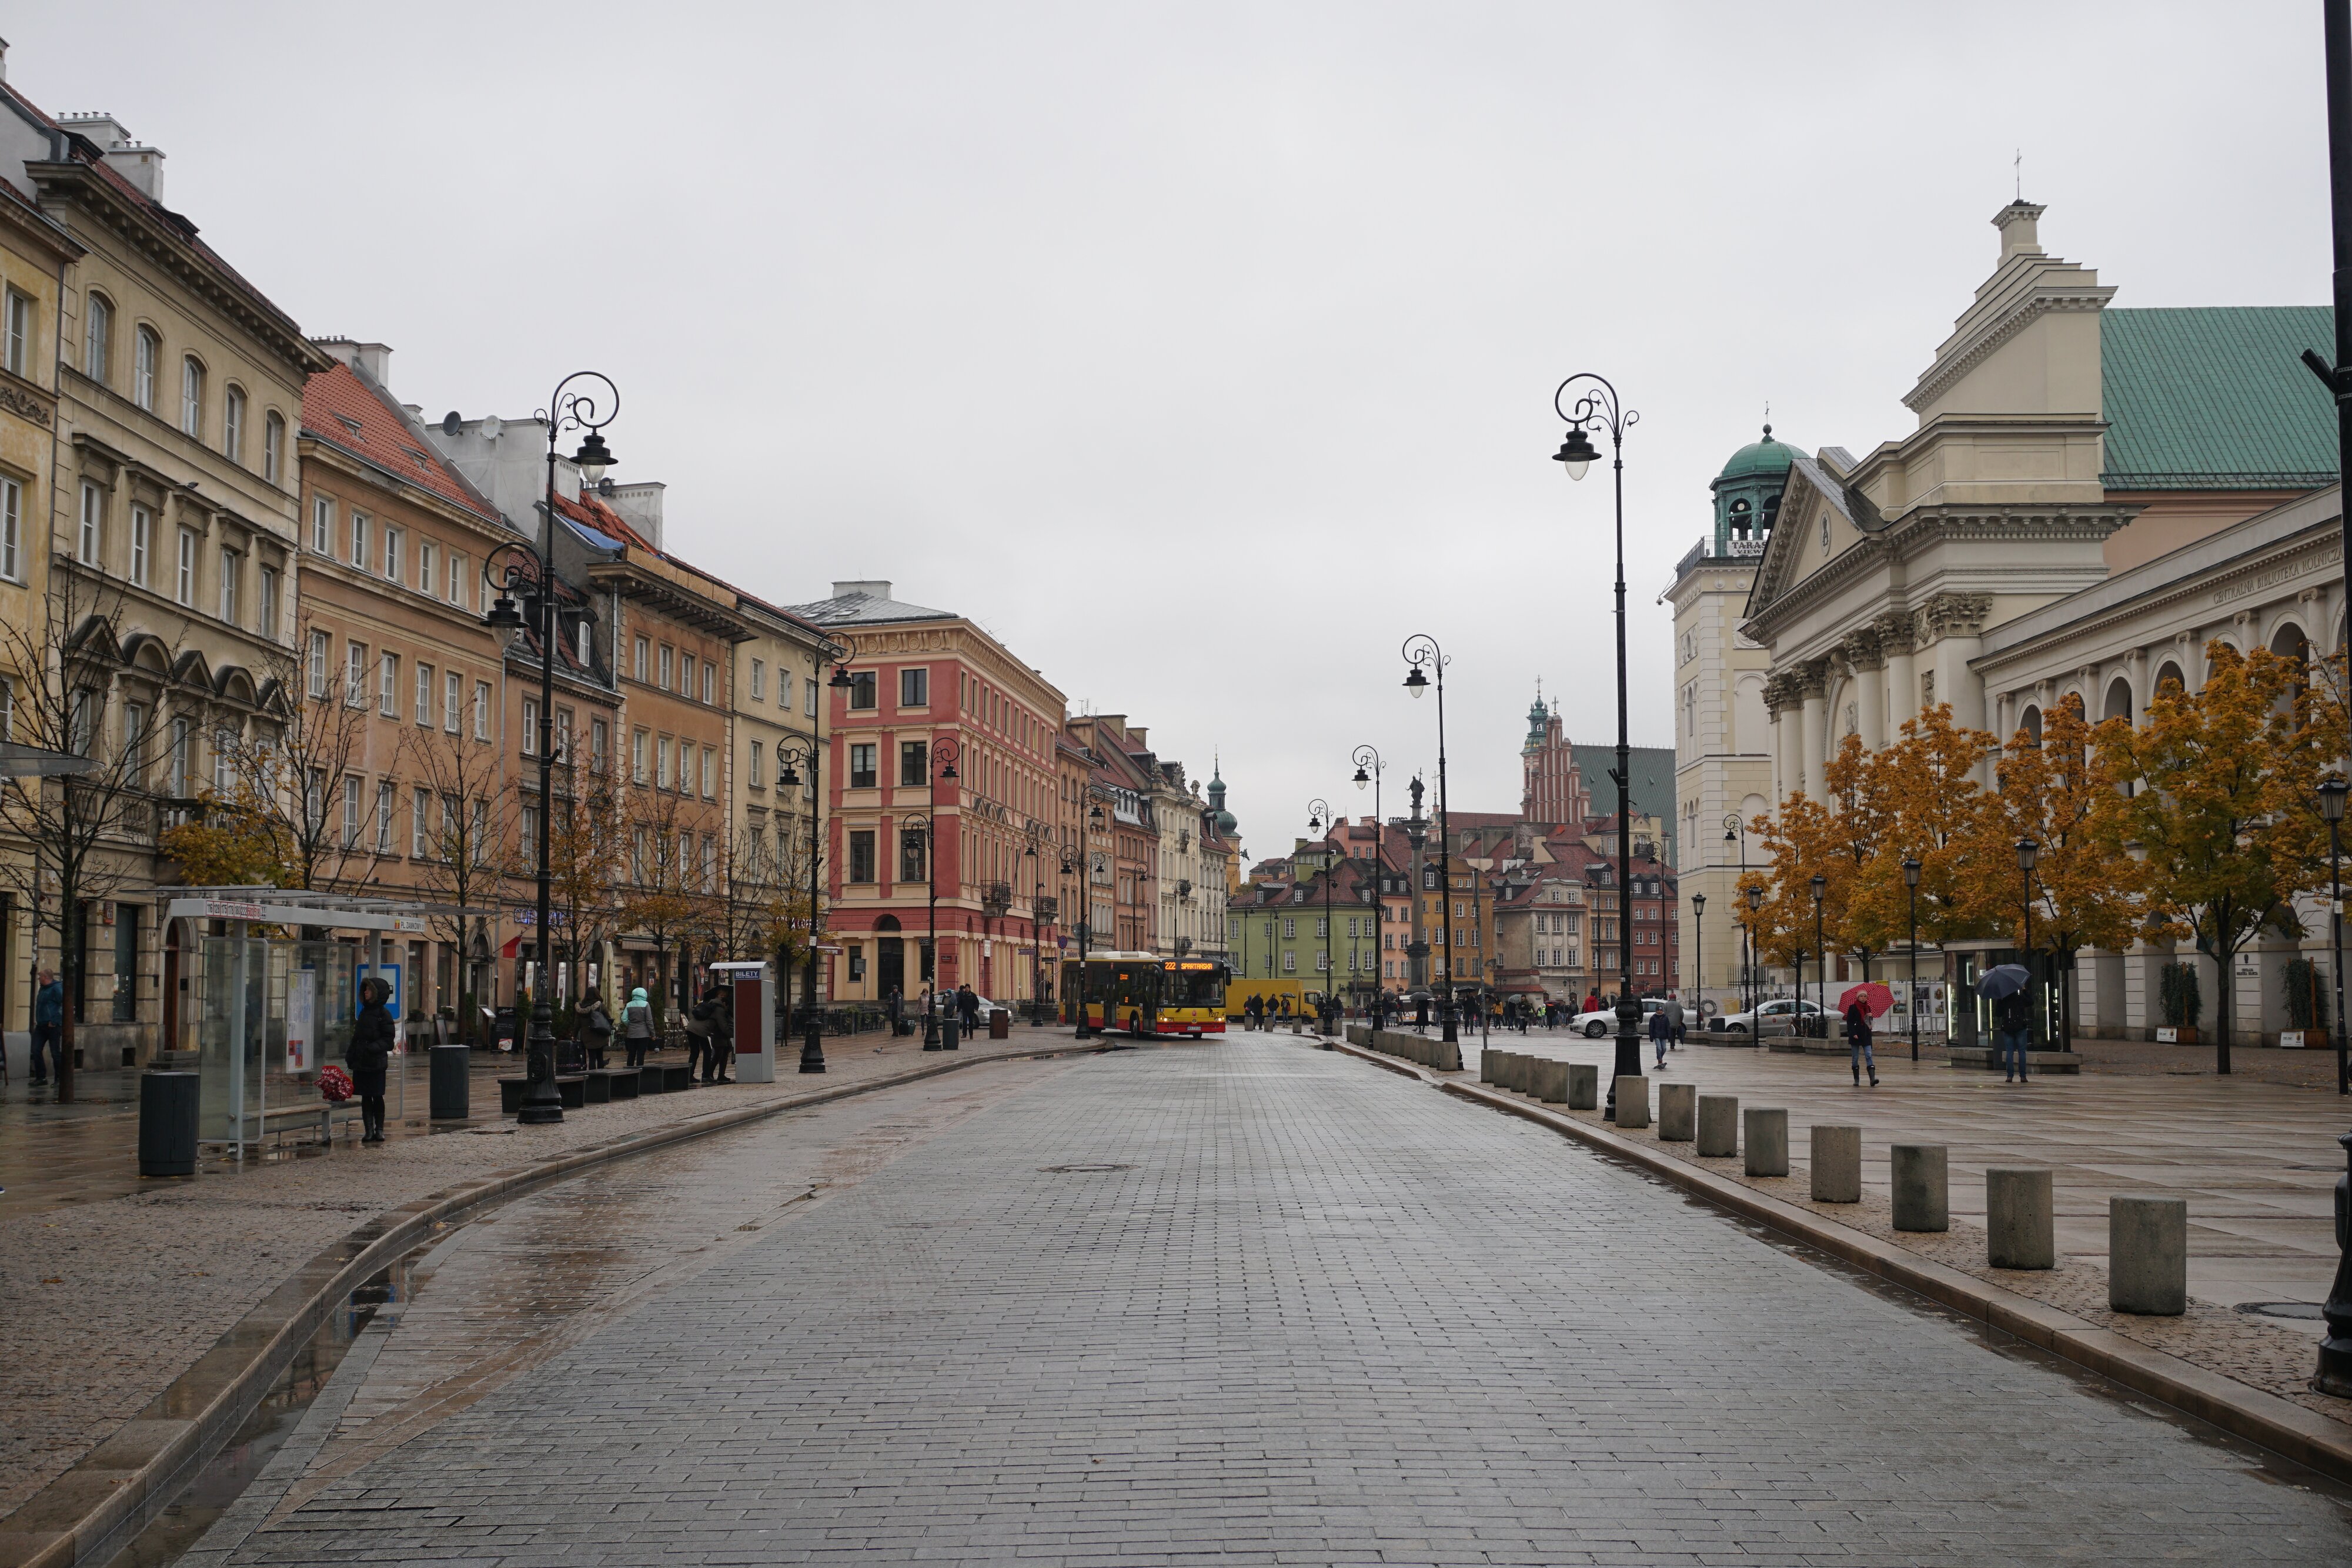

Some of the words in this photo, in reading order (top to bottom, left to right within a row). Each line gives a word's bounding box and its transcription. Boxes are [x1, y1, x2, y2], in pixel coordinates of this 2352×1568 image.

[2213, 579, 2254, 604] CENTRALNA
[2257, 563, 2299, 589] BIBLIOTEKA
[2302, 546, 2344, 573] ROLNICZA
[406, 922, 421, 930] ZAMKOWY
